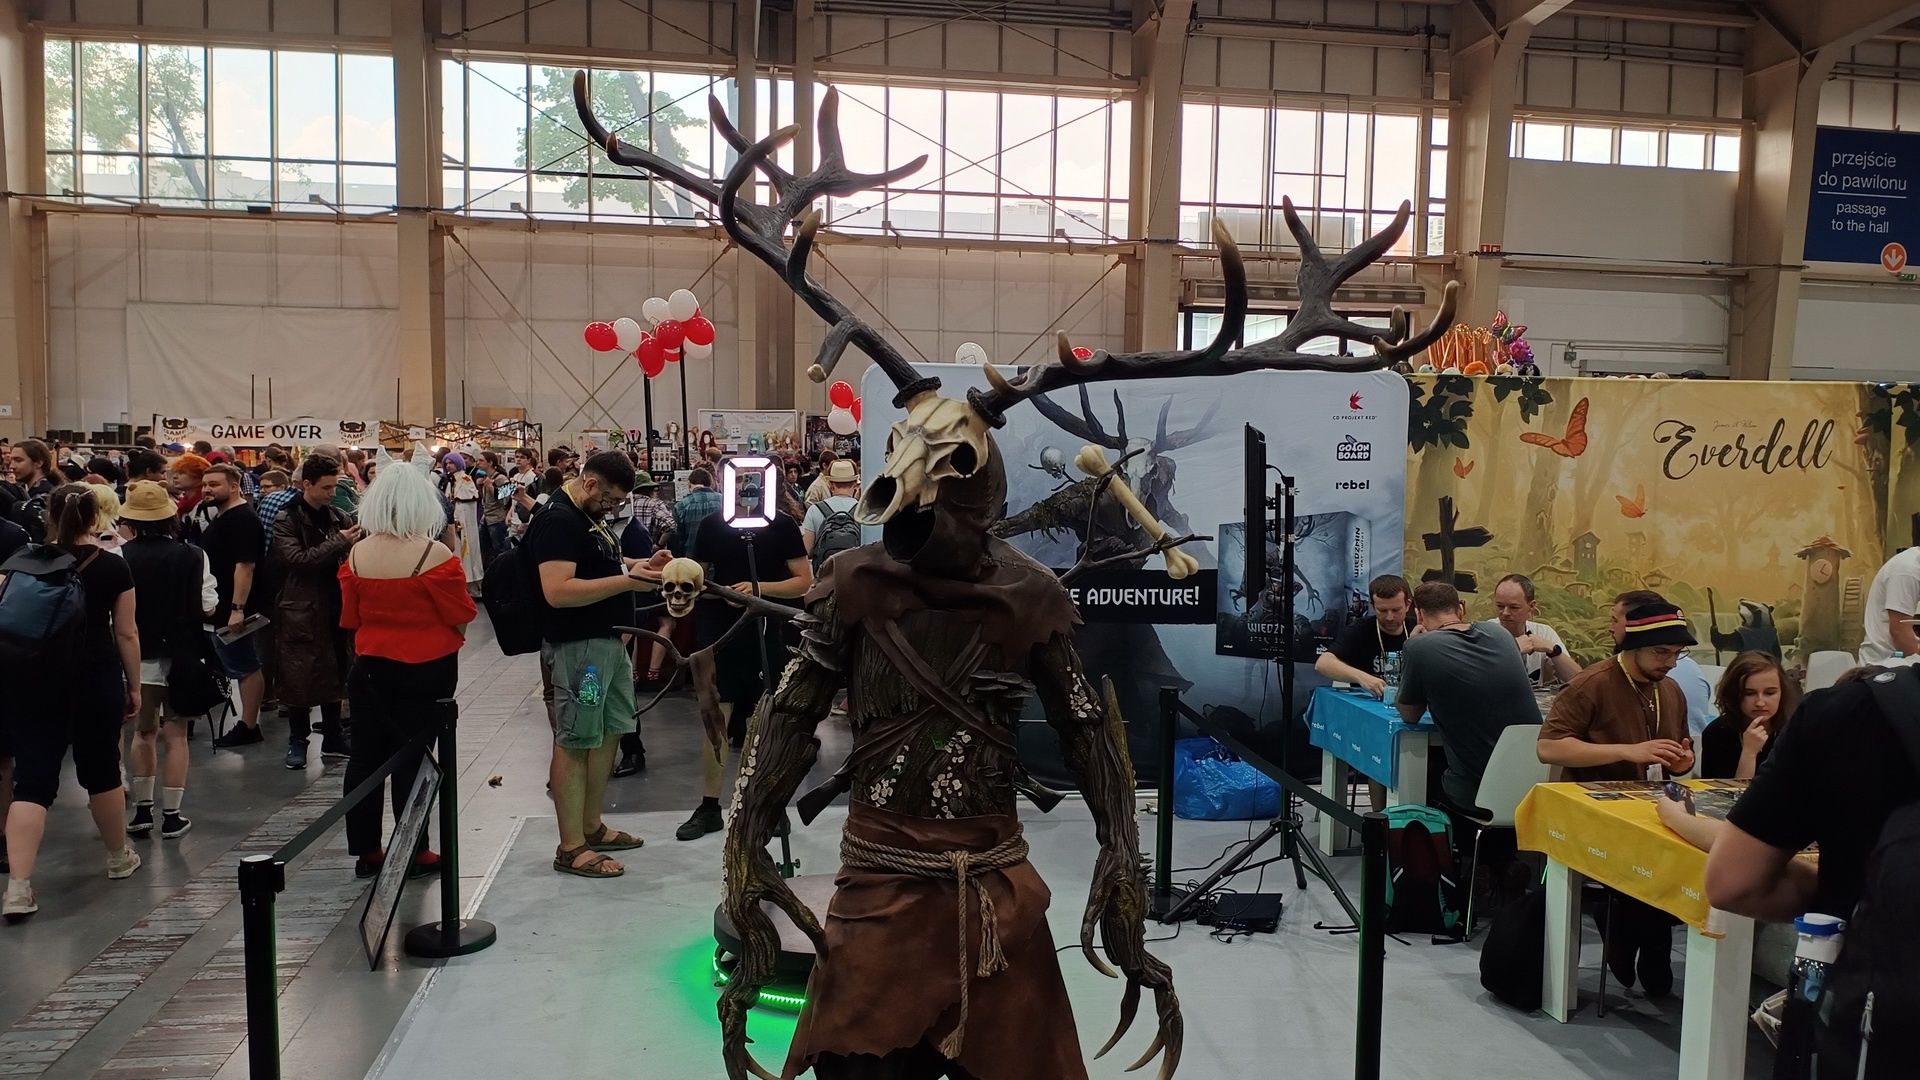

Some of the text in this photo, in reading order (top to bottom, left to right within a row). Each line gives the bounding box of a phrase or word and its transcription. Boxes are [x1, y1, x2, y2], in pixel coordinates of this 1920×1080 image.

[1832, 152, 1897, 169] przejście
[1818, 171, 1907, 191] do pawilonu
[1836, 203, 1887, 217] passage
[1831, 218, 1889, 233] to the hall
[211, 424, 322, 439] GAME OVER
[1338, 451, 1370, 460] BOARD
[1653, 418, 1835, 480] Everdell
[1335, 479, 1370, 490] rebel
[1086, 585, 1200, 606] ADVENTURE!
[1548, 829, 1567, 841] rebel
[1588, 846, 1607, 860] rebel
[1632, 864, 1653, 879] rebel
[1681, 884, 1700, 901] rebel
